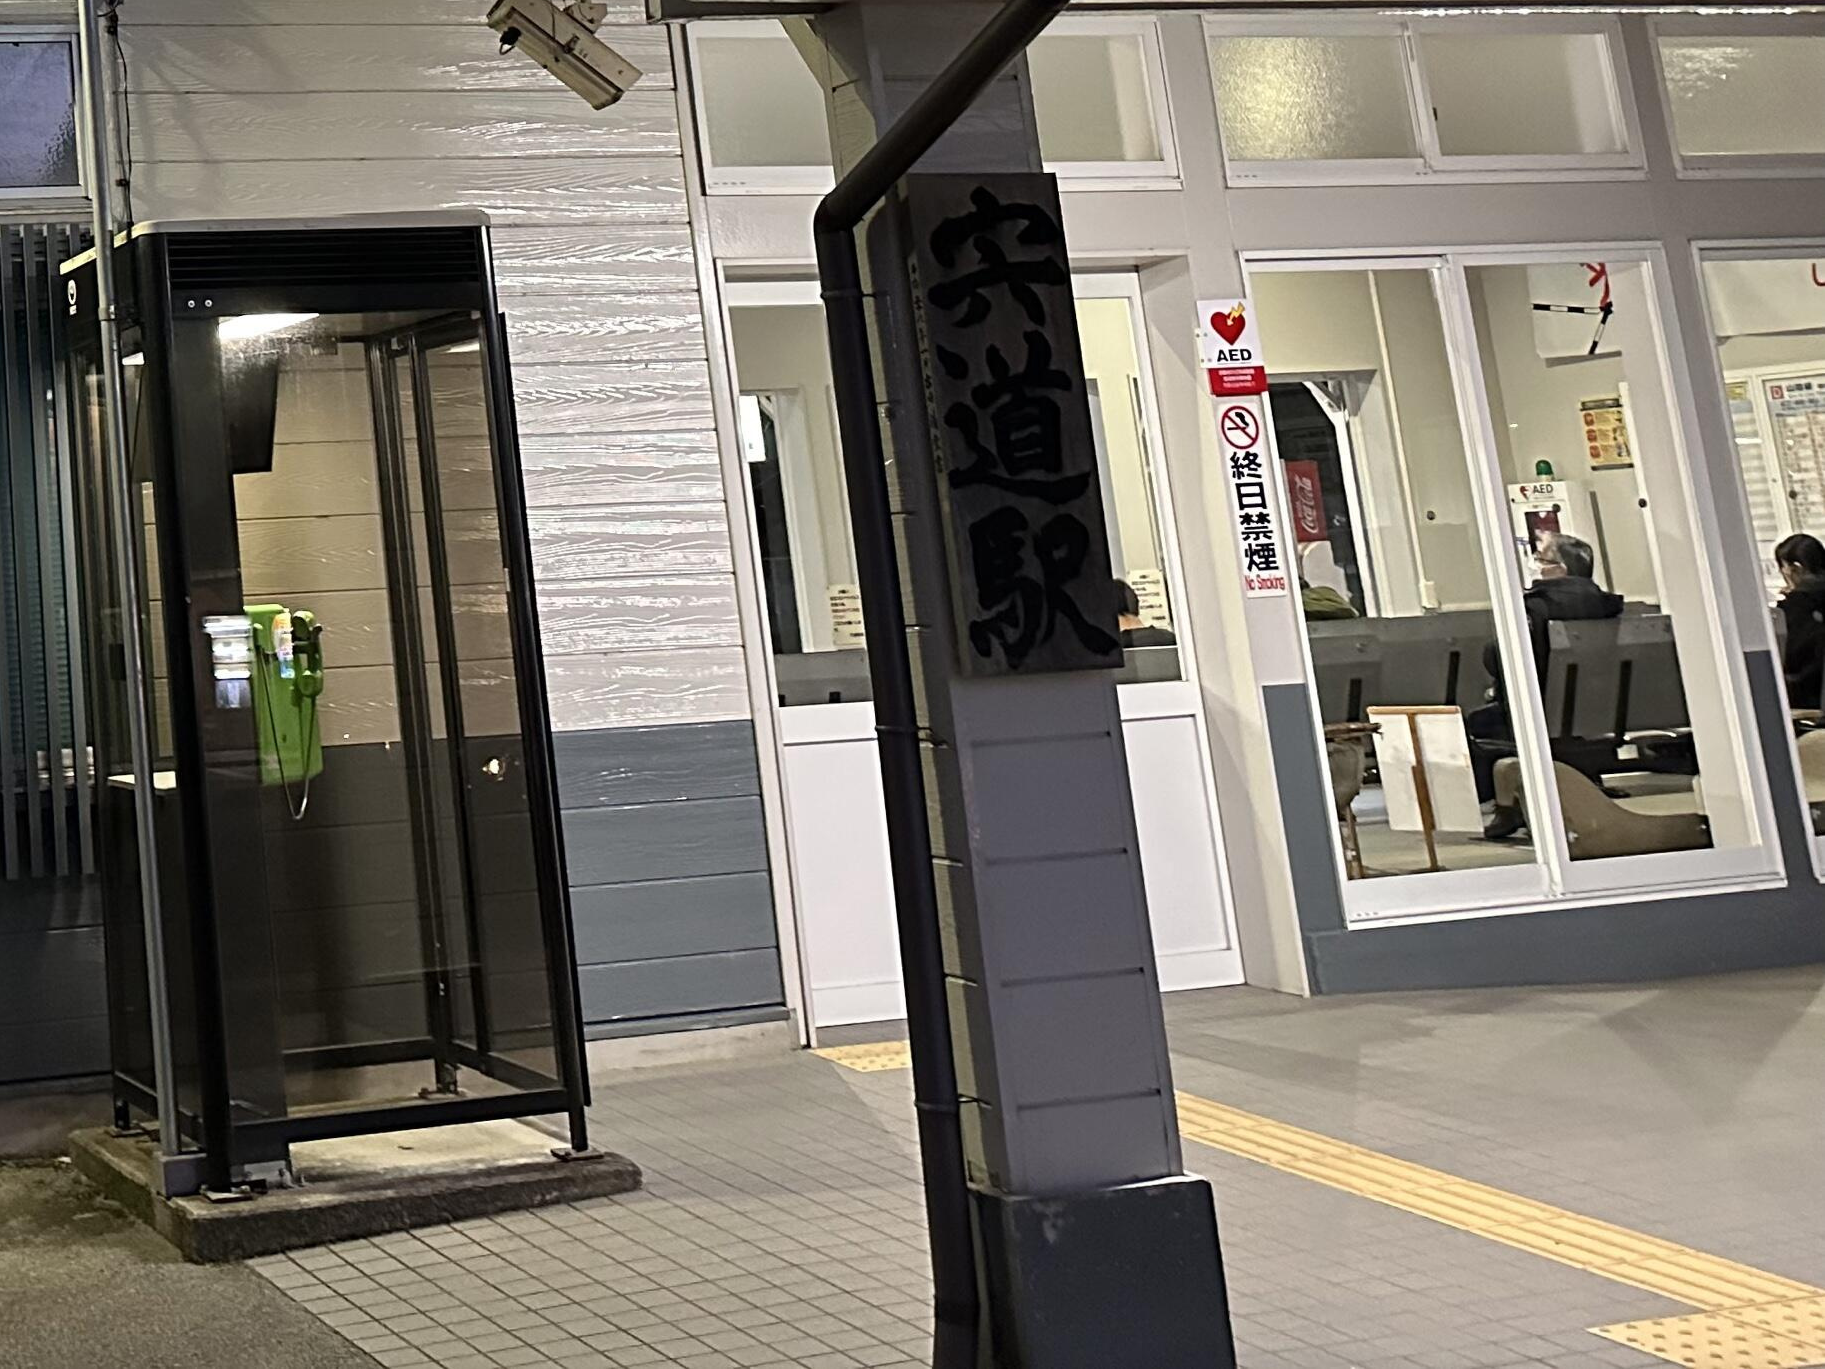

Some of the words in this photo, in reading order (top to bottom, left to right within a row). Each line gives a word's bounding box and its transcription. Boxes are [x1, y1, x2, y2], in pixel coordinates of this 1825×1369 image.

[1216, 348, 1253, 363] AED
[927, 185, 1120, 668] 宍道駅
[1532, 483, 1554, 494] AED
[1229, 450, 1280, 573] 終日禁煙
[1244, 574, 1255, 590] No
[1256, 573, 1286, 591] Smoking
